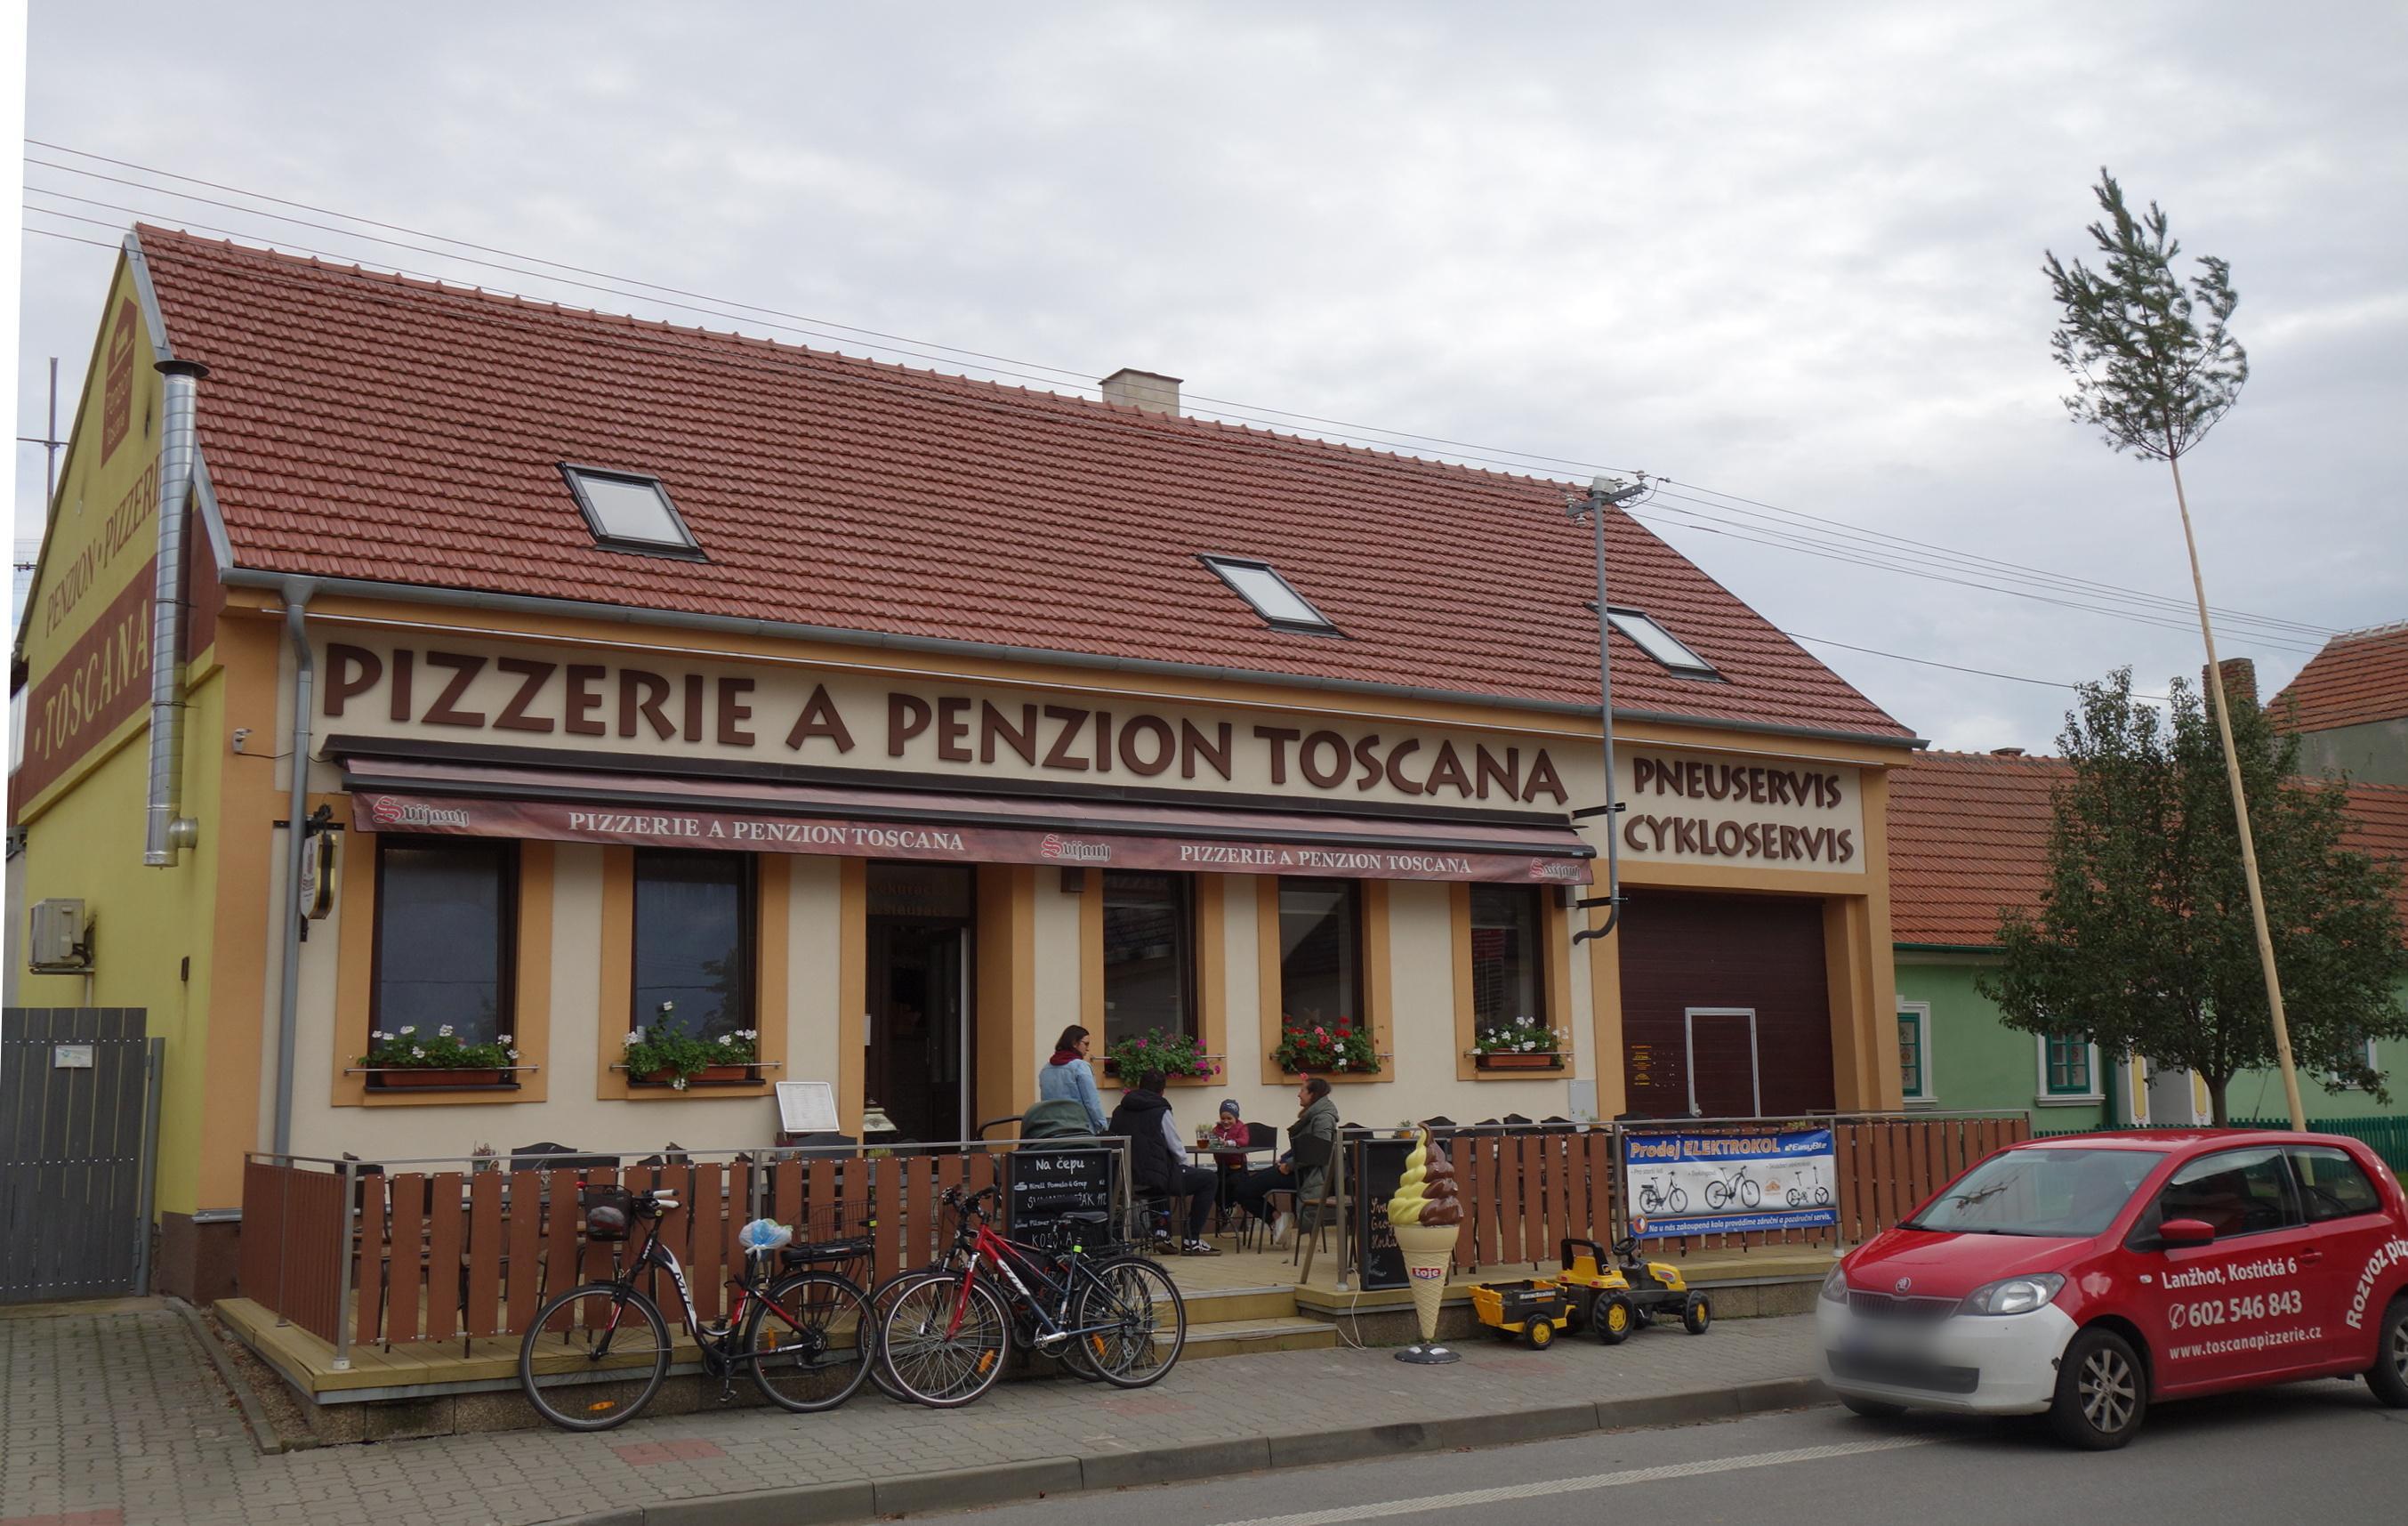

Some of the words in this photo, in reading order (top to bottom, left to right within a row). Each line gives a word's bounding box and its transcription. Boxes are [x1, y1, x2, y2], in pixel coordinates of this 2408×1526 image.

[46, 538, 95, 638] PENZION
[104, 454, 161, 569] PIZZERI
[45, 600, 148, 760] TOSCANA
[324, 642, 754, 747] PIZZERIE
[786, 682, 856, 755] A
[889, 692, 1232, 781] PENZION
[1253, 725, 1569, 805] TOSCANA
[1633, 757, 1842, 809] PNEUSERVIS
[568, 811, 699, 836] PIZZERIE
[709, 821, 725, 838] A
[733, 821, 847, 844] PENZION
[851, 828, 965, 852] TOSCANA
[1624, 813, 1855, 863] CYKLOSERVIS
[1180, 845, 1276, 865] PIZZERIE
[1279, 852, 1293, 866] A
[1296, 851, 1381, 870] PENZION
[1387, 855, 1473, 875] TOSCANA
[1035, 1159, 1051, 1171] Na
[1056, 1156, 1085, 1175] čepu
[1630, 1140, 1681, 1160] Prodej
[1684, 1138, 1781, 1156] ELEKTROKOL
[1649, 1224, 1657, 1232] Na
[1664, 1223, 1676, 1231] nás
[1677, 1222, 1709, 1231] zakoupená
[1711, 1219, 1724, 1228] kola
[1757, 1216, 1778, 1225] záruční
[2162, 1268, 2226, 1289] Lanžhot,
[2227, 1257, 2285, 1281] Kostická
[2288, 1257, 2298, 1274] 6
[2346, 1248, 2389, 1329] Rozvoz
[2384, 1233, 2408, 1265] piz
[2188, 1300, 2225, 1328] 602
[2230, 1296, 2265, 1321] 546
[2269, 1290, 2303, 1317] 843
[2170, 1327, 2323, 1360] www.toscanapizzerie.cz
